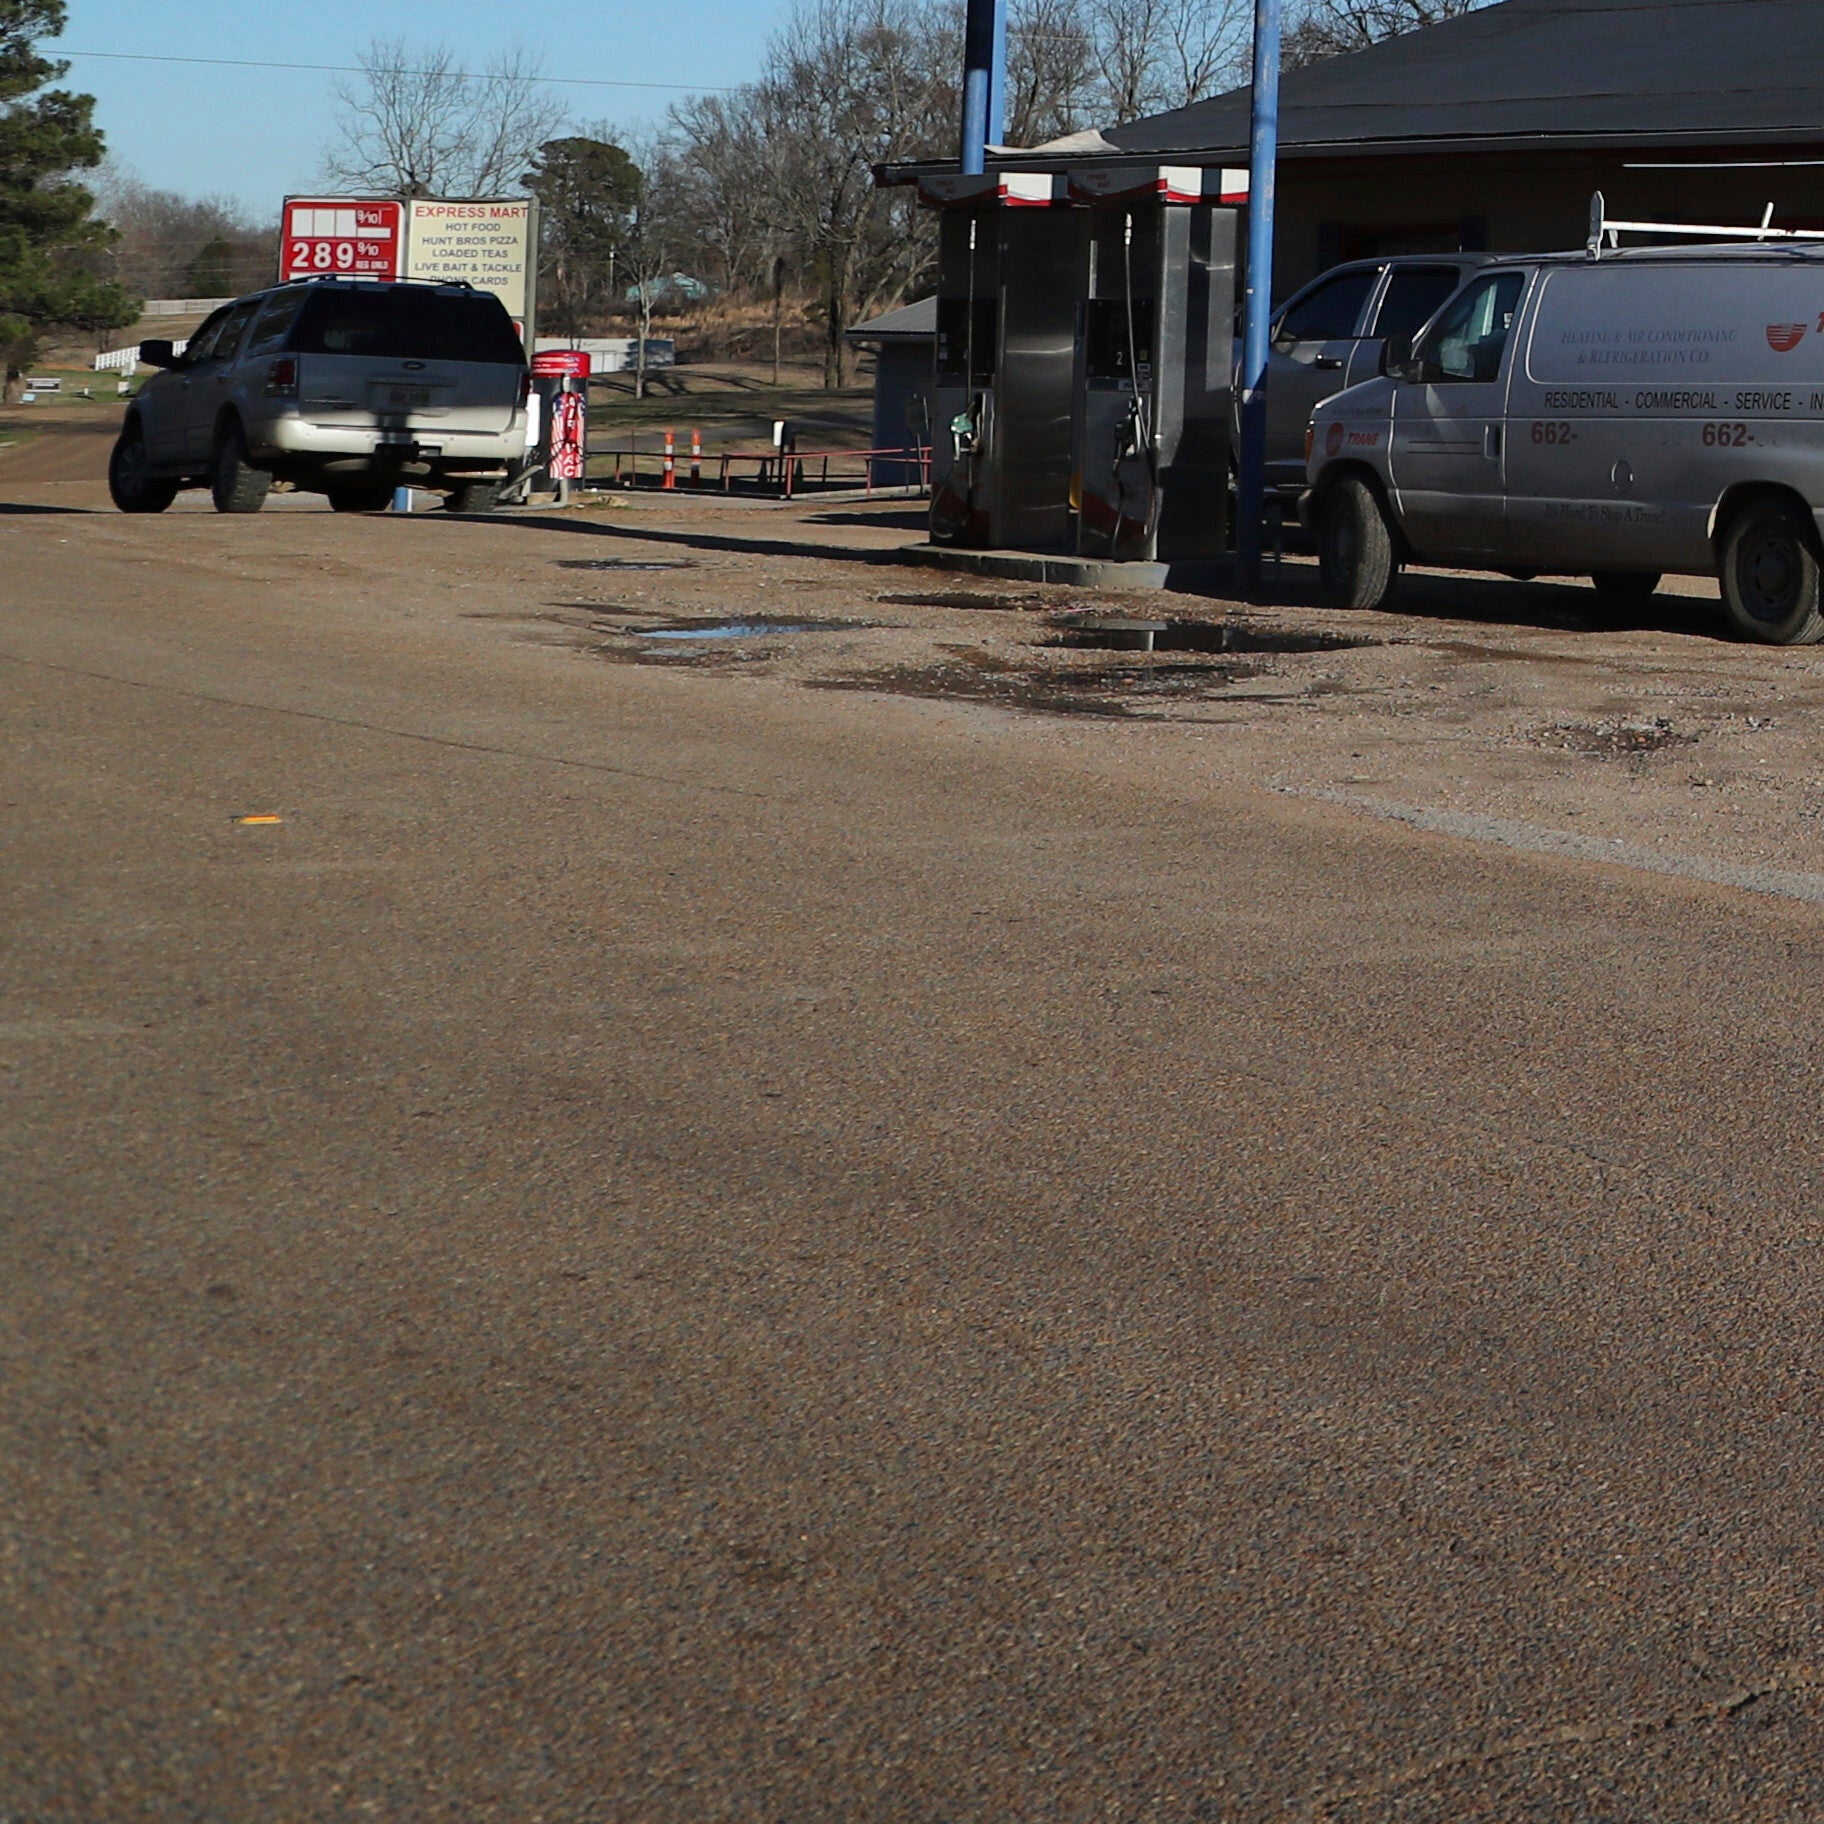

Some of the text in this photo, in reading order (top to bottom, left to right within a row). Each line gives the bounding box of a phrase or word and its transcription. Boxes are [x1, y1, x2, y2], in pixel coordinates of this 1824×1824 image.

[415, 205, 528, 219] EXPRESS MART
[445, 222, 501, 232] HOT FOOD
[422, 236, 519, 245] HUNT BROS PIZZA
[291, 241, 354, 269] 289
[432, 248, 509, 258] LOADED TEAS
[414, 262, 522, 273] LIVE BAIT & TACKLE
[471, 276, 509, 286] CARDS
[1648, 328, 1738, 343] CONDITIONING
[1116, 351, 1123, 366] 2
[1589, 349, 1687, 364] REFRIGERATION
[1544, 391, 1619, 409] RESIDENTIAL
[1634, 391, 1717, 410] COMMERCIAL
[1734, 391, 1792, 410] SERVICE
[1347, 431, 1380, 447] TRANE
